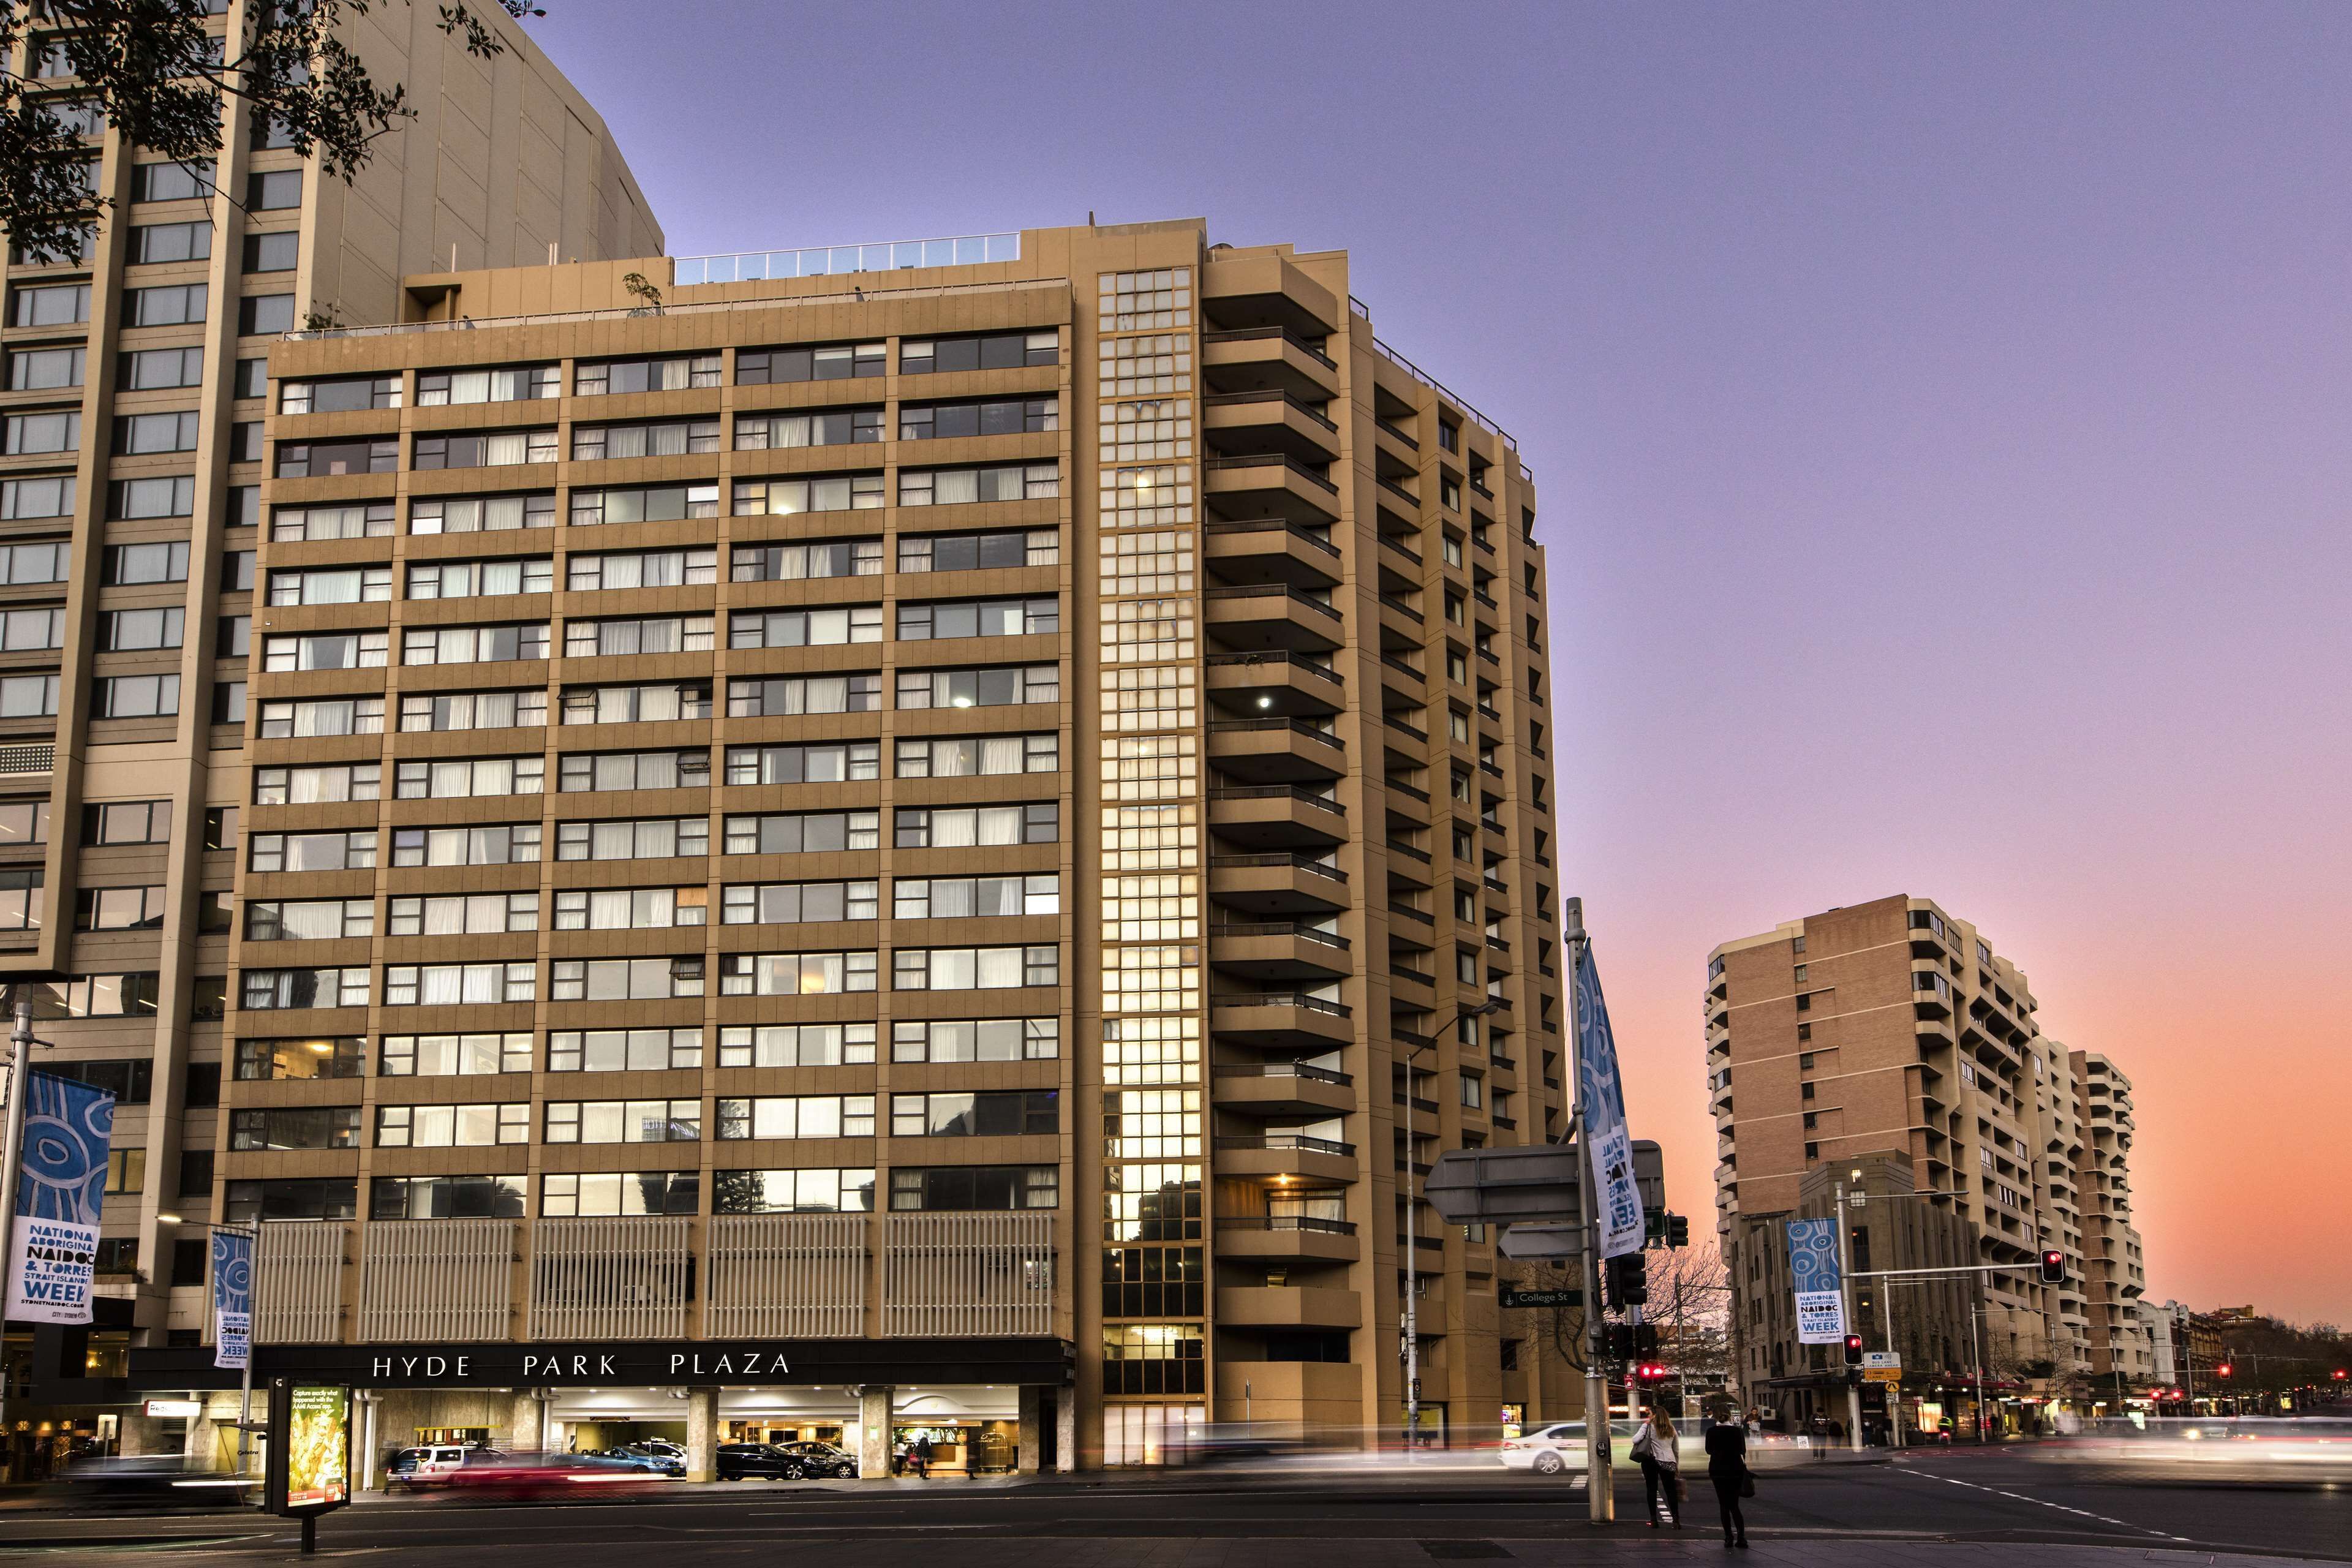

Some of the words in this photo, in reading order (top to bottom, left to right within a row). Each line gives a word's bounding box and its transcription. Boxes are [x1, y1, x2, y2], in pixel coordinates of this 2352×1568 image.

[29, 1224, 94, 1243] NATIONA
[26, 1246, 94, 1265] NAIDOC
[25, 1261, 37, 1271] &
[44, 1262, 92, 1276] TORRES
[24, 1272, 55, 1281] STRAIT
[57, 1275, 88, 1284] ISLANDE
[1520, 1294, 1555, 1303] College
[1558, 1292, 1568, 1301] St
[1803, 1322, 1839, 1332] WEEK
[373, 1357, 469, 1377] HYDE
[524, 1355, 615, 1376] PARK
[671, 1354, 789, 1374] PLAZA
